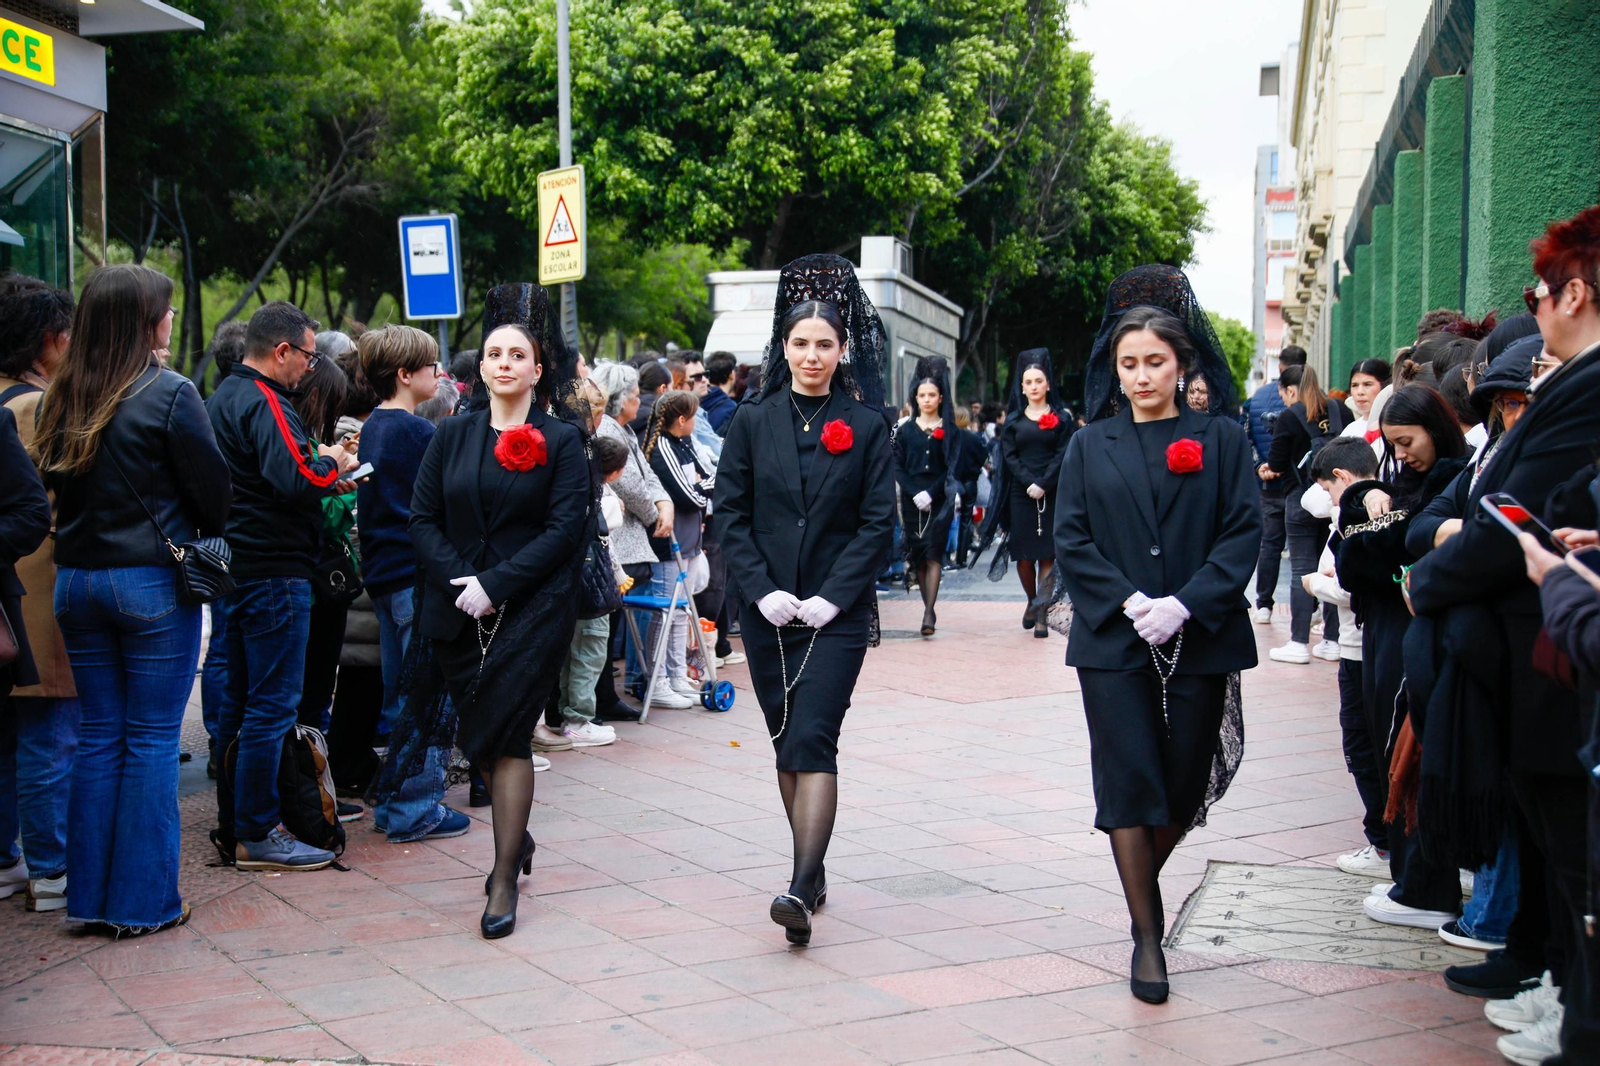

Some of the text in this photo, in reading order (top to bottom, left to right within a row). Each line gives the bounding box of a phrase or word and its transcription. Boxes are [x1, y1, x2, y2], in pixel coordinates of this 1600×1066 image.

[2, 28, 42, 72] CE
[542, 175, 577, 190] ATENCIÓN
[550, 249, 571, 261] ZONA
[544, 261, 578, 274] ESCOLAR
